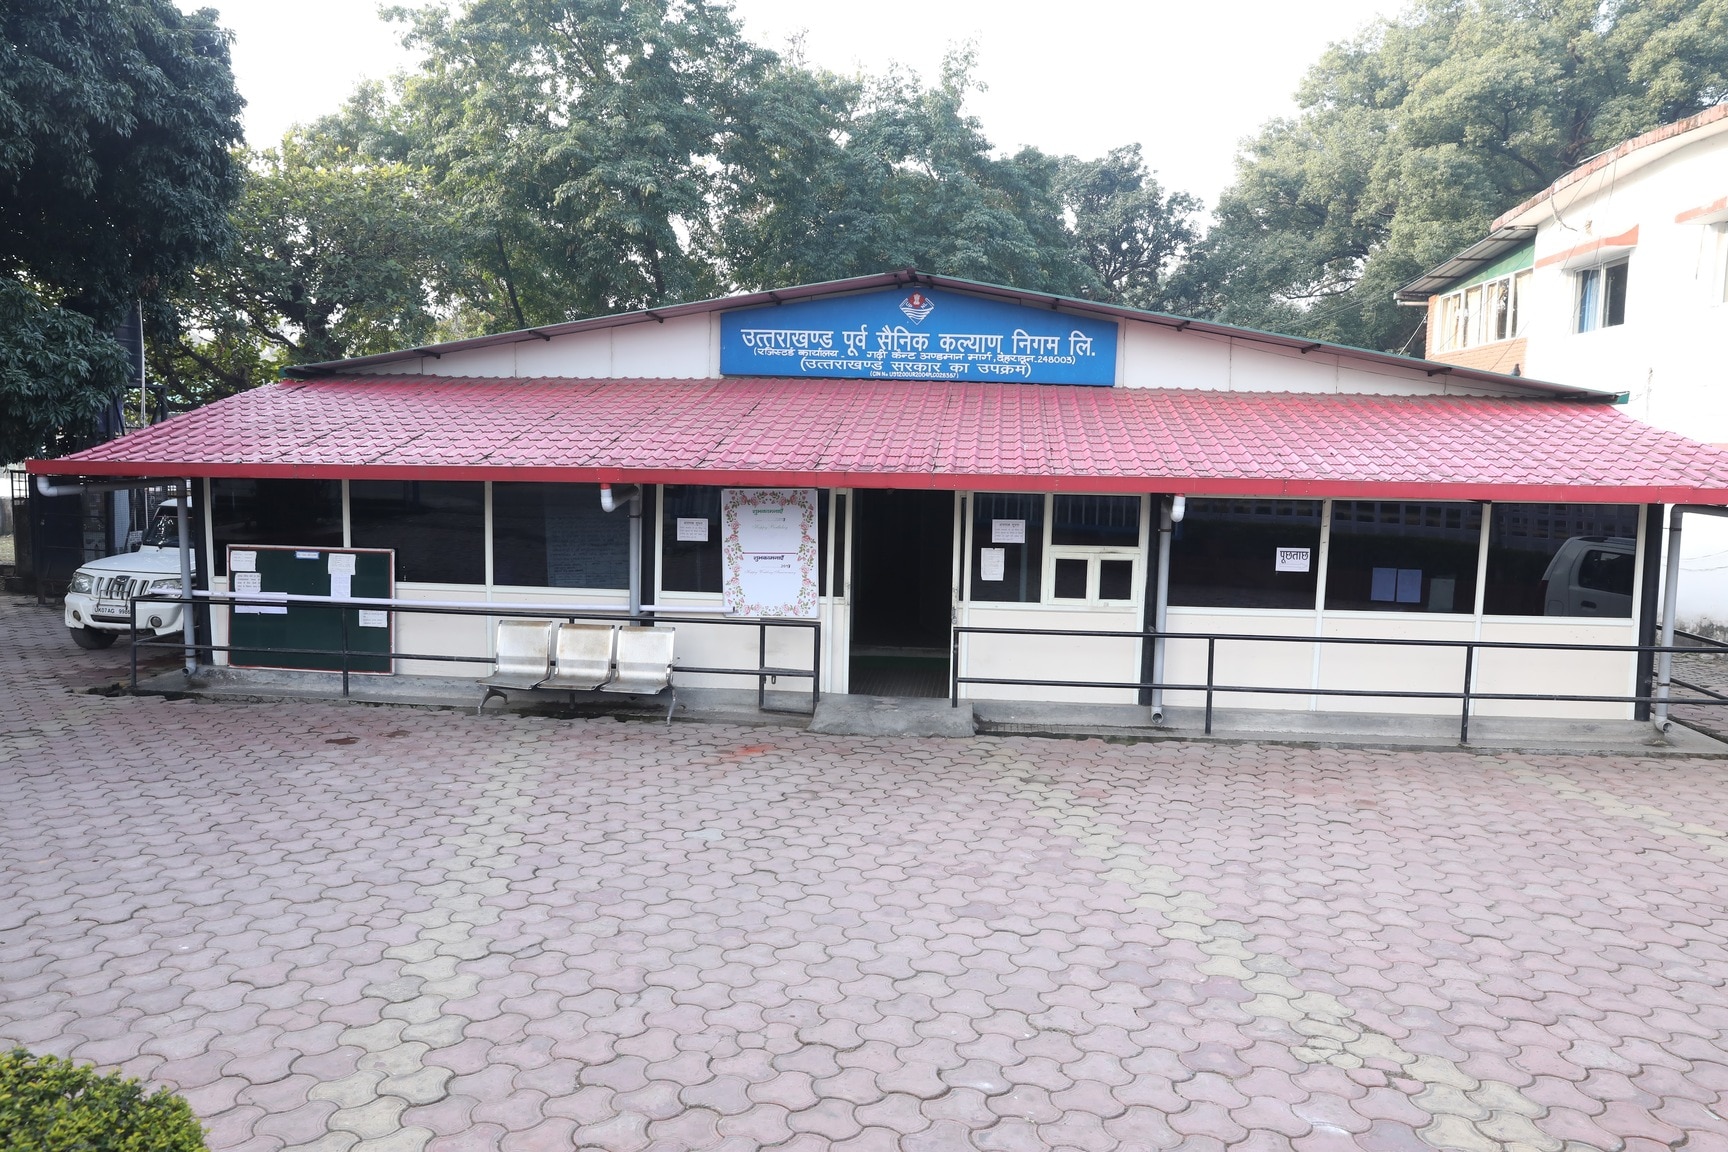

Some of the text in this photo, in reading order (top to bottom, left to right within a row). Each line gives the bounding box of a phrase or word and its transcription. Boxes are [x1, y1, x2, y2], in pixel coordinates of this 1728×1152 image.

[740, 324, 1096, 356] उत्तराखण्ड पूर्व सैनिक कल्याण निगम लि.
[798, 348, 839, 358] कार्यालय
[800, 357, 1031, 377] (उत्तराखण्ड सरकार का उपक्रम)
[1280, 550, 1309, 564] पूछताछ
